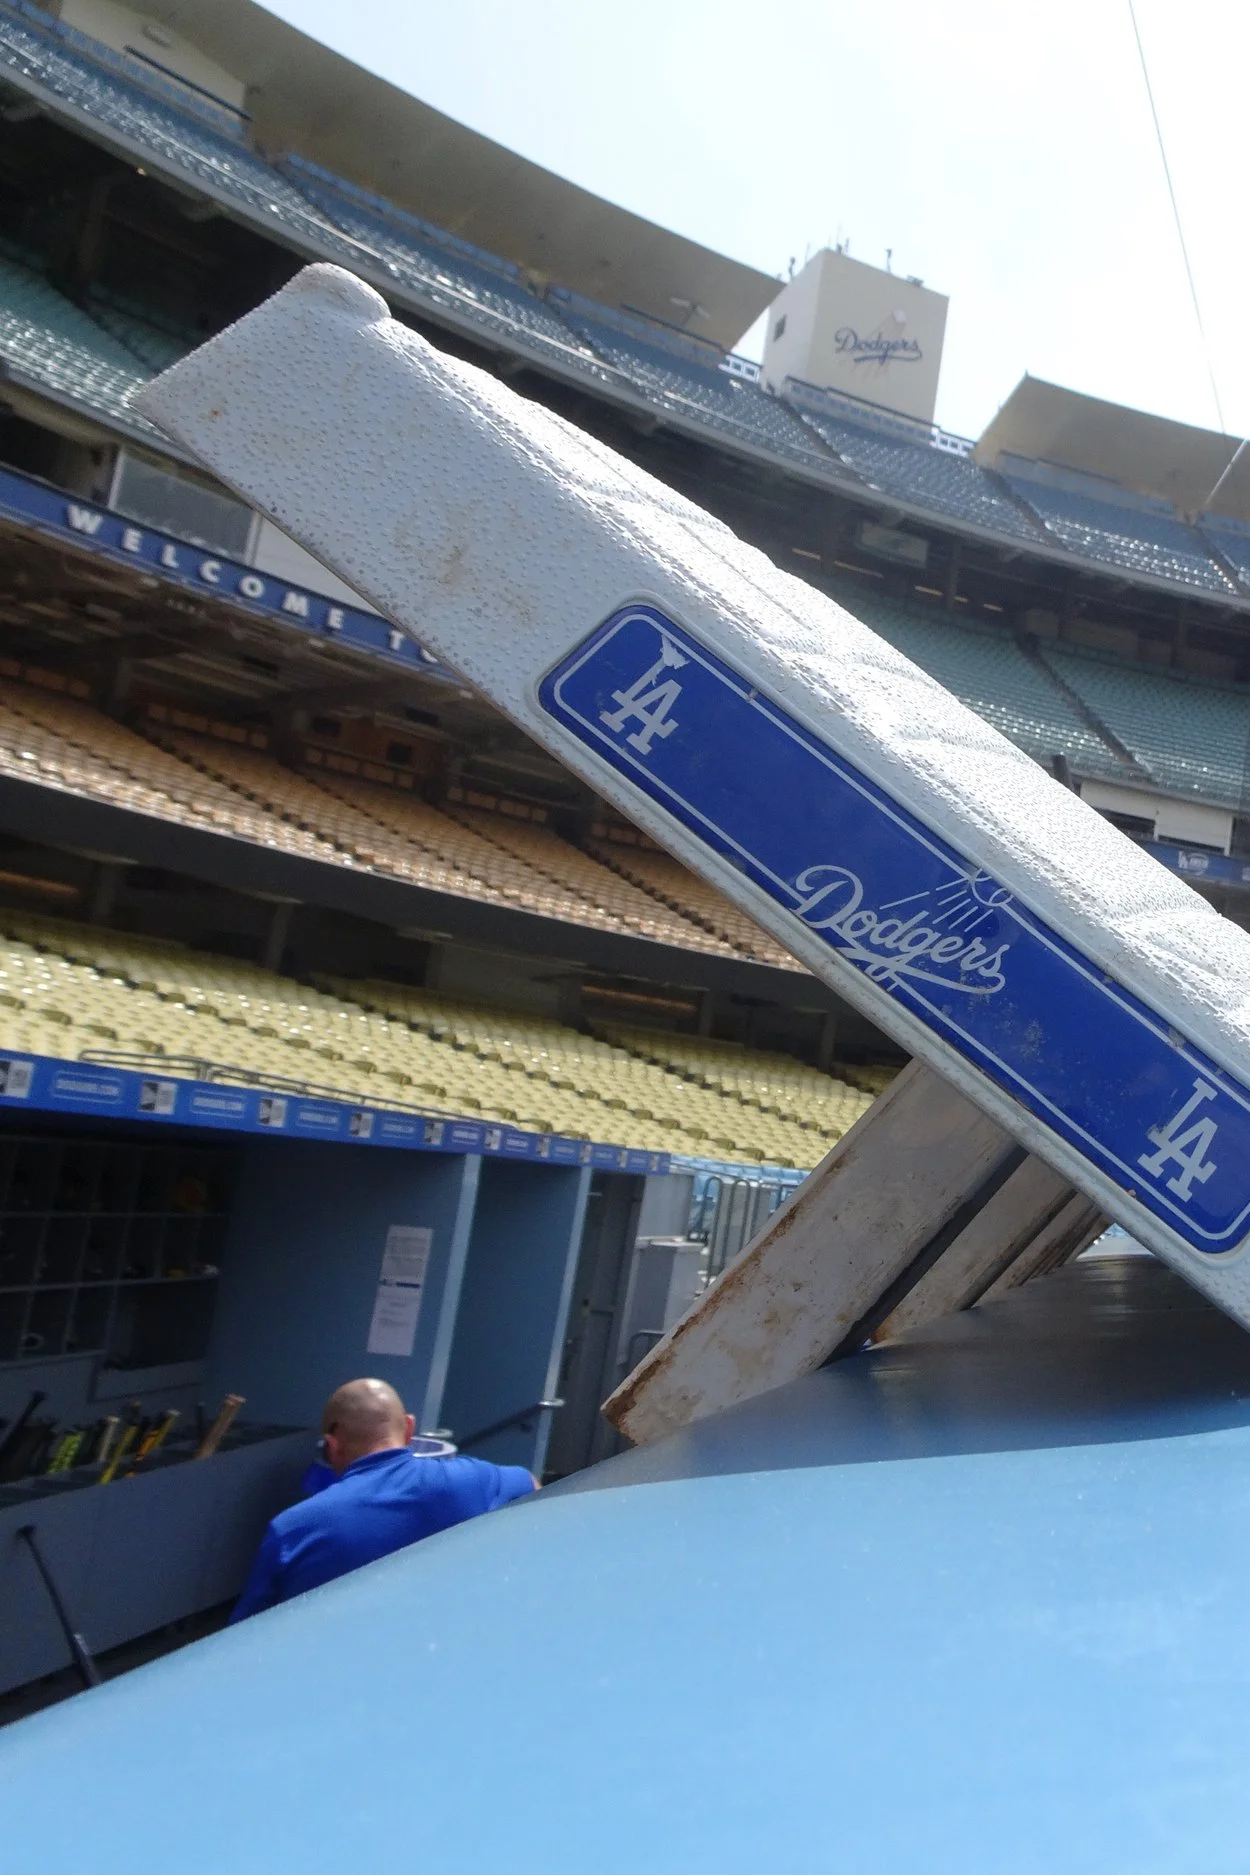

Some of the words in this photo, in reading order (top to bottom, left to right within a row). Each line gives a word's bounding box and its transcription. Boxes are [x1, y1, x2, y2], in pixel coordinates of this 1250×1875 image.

[834, 326, 923, 366] Dodgers
[67, 503, 345, 630] WELCOME
[789, 864, 1010, 994] Dodgers
[1136, 1077, 1218, 1203] LA
